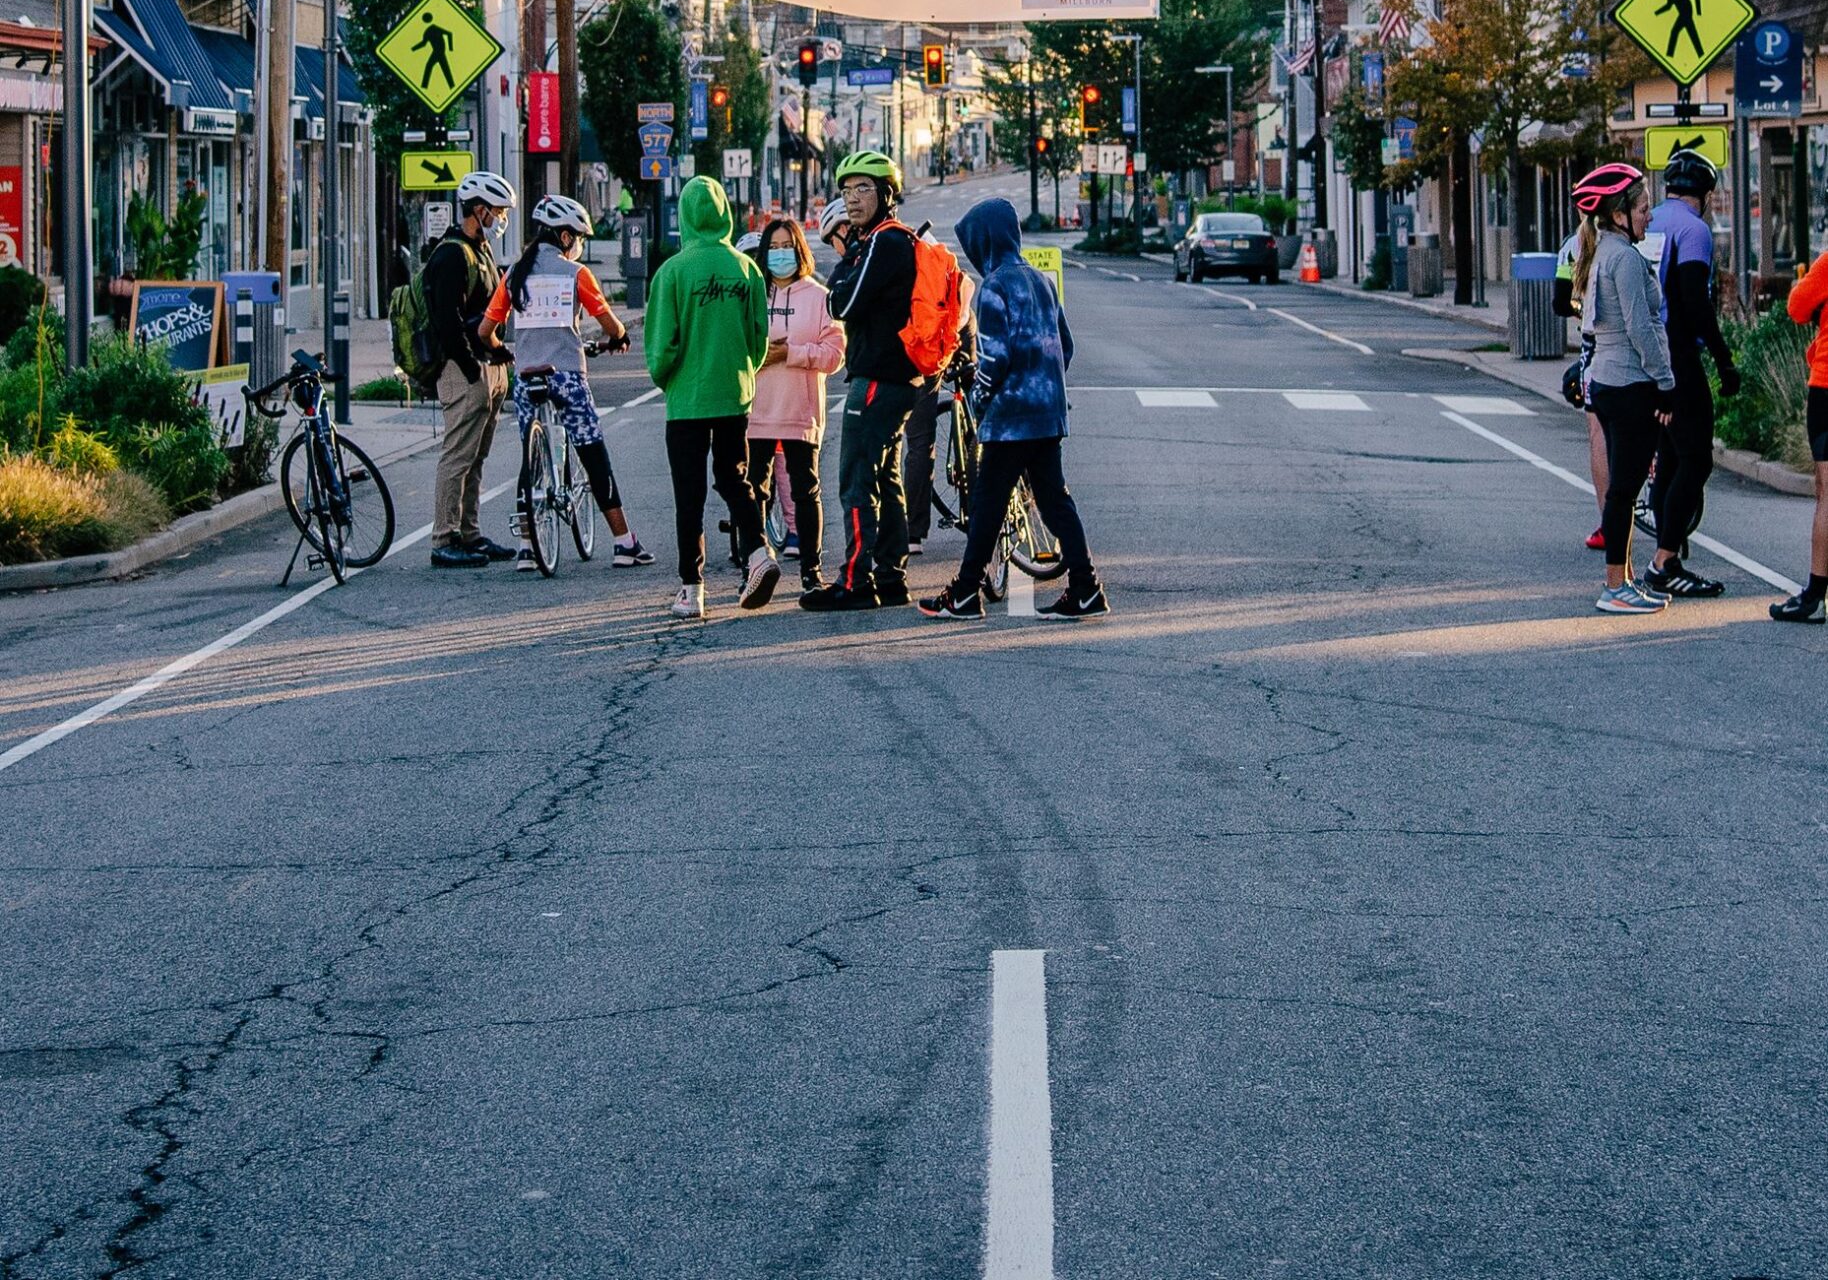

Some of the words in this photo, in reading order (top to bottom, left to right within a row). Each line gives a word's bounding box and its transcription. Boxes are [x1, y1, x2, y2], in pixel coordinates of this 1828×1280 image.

[1764, 31, 1782, 56] P
[540, 77, 550, 109] barre
[1753, 100, 1777, 111] Lot
[1782, 100, 1790, 111] 4
[640, 108, 672, 118] NORTH
[540, 109, 551, 135] pure
[643, 134, 671, 148] 577
[1028, 251, 1053, 260] STATE
